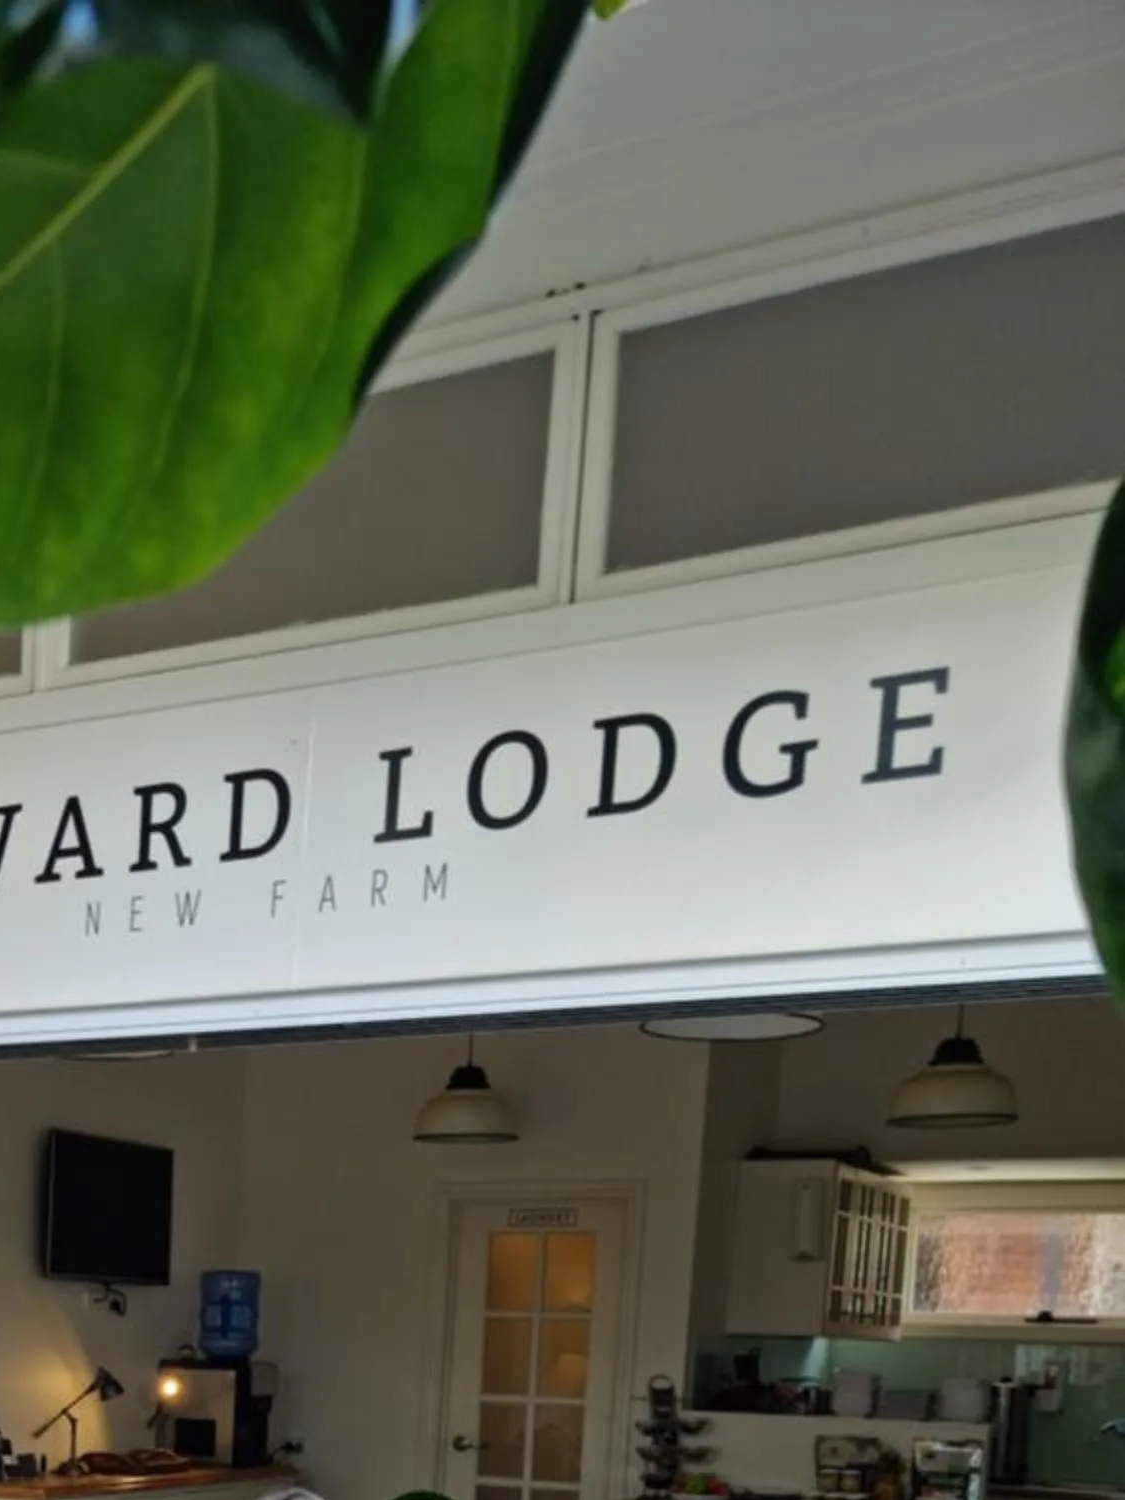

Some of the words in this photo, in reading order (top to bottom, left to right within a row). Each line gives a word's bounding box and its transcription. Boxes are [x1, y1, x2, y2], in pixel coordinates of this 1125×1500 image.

[372, 665, 950, 843] LODGE
[84, 890, 202, 937] NEW
[270, 862, 449, 919] FARM
